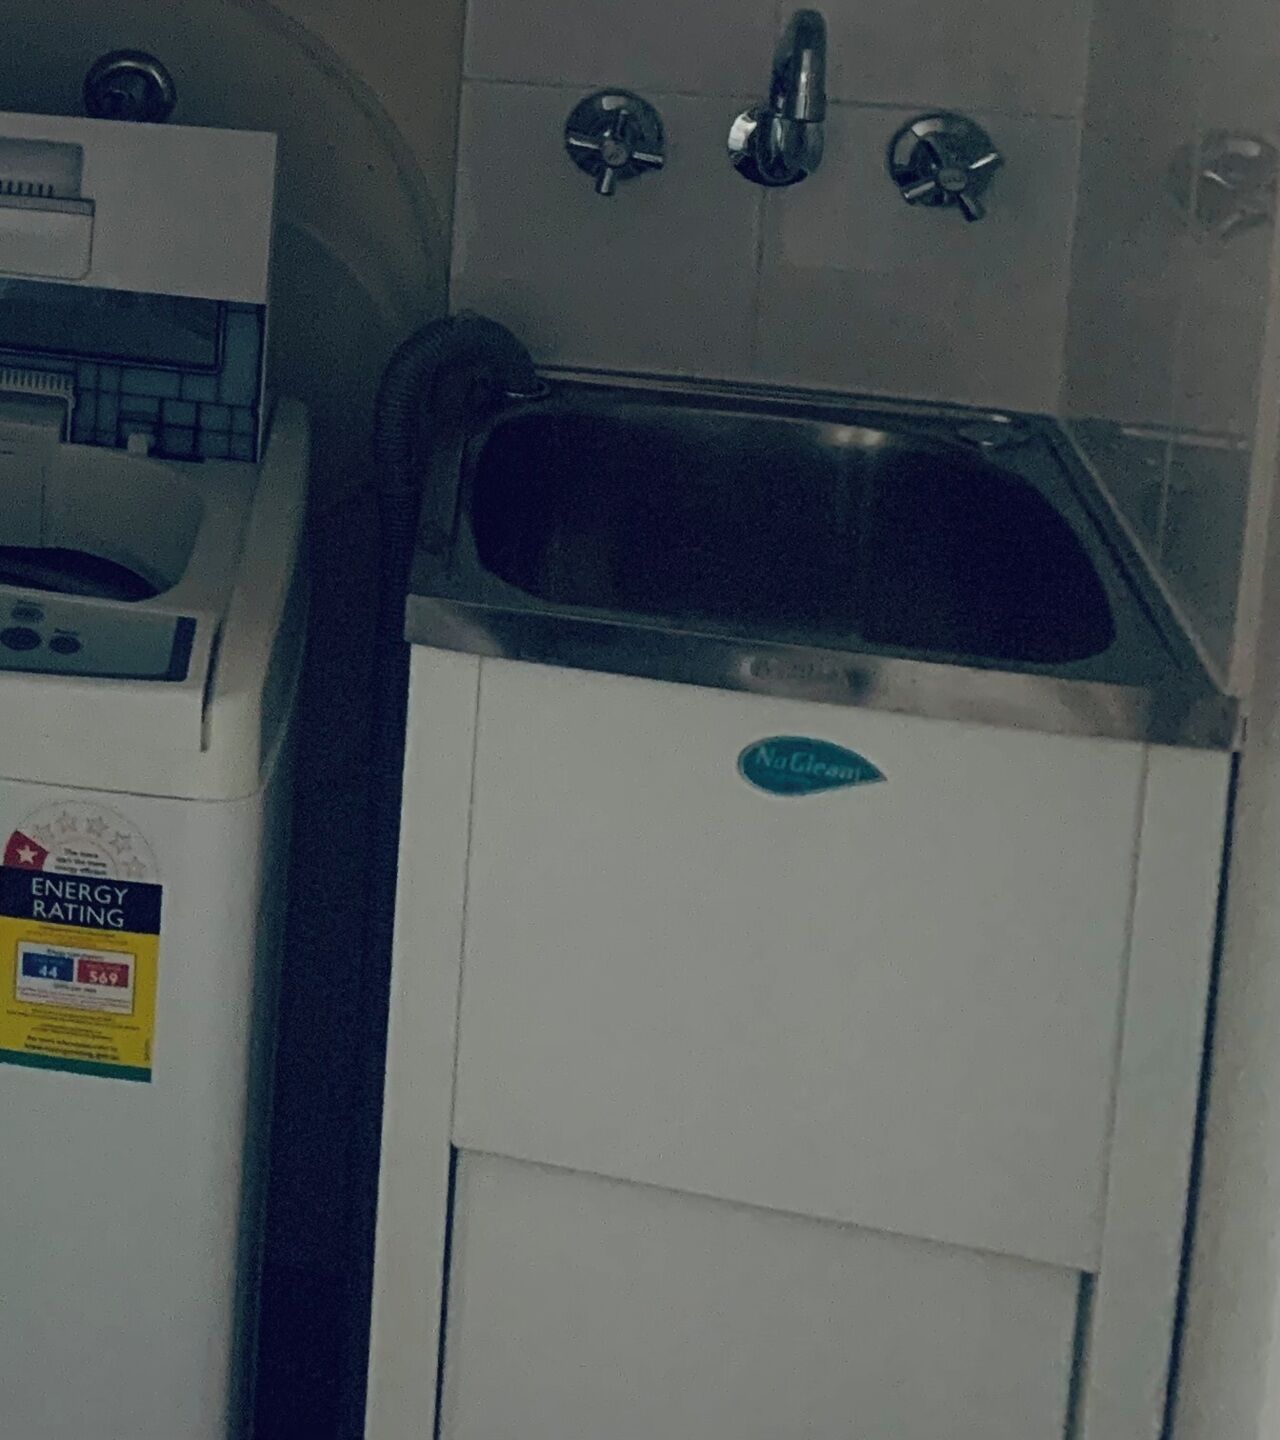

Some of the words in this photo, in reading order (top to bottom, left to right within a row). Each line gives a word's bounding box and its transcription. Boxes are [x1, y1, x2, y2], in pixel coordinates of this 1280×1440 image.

[32, 877, 129, 906] ENERGY
[32, 900, 125, 928] RATING
[38, 965, 58, 979] 44
[88, 970, 119, 986] 569
